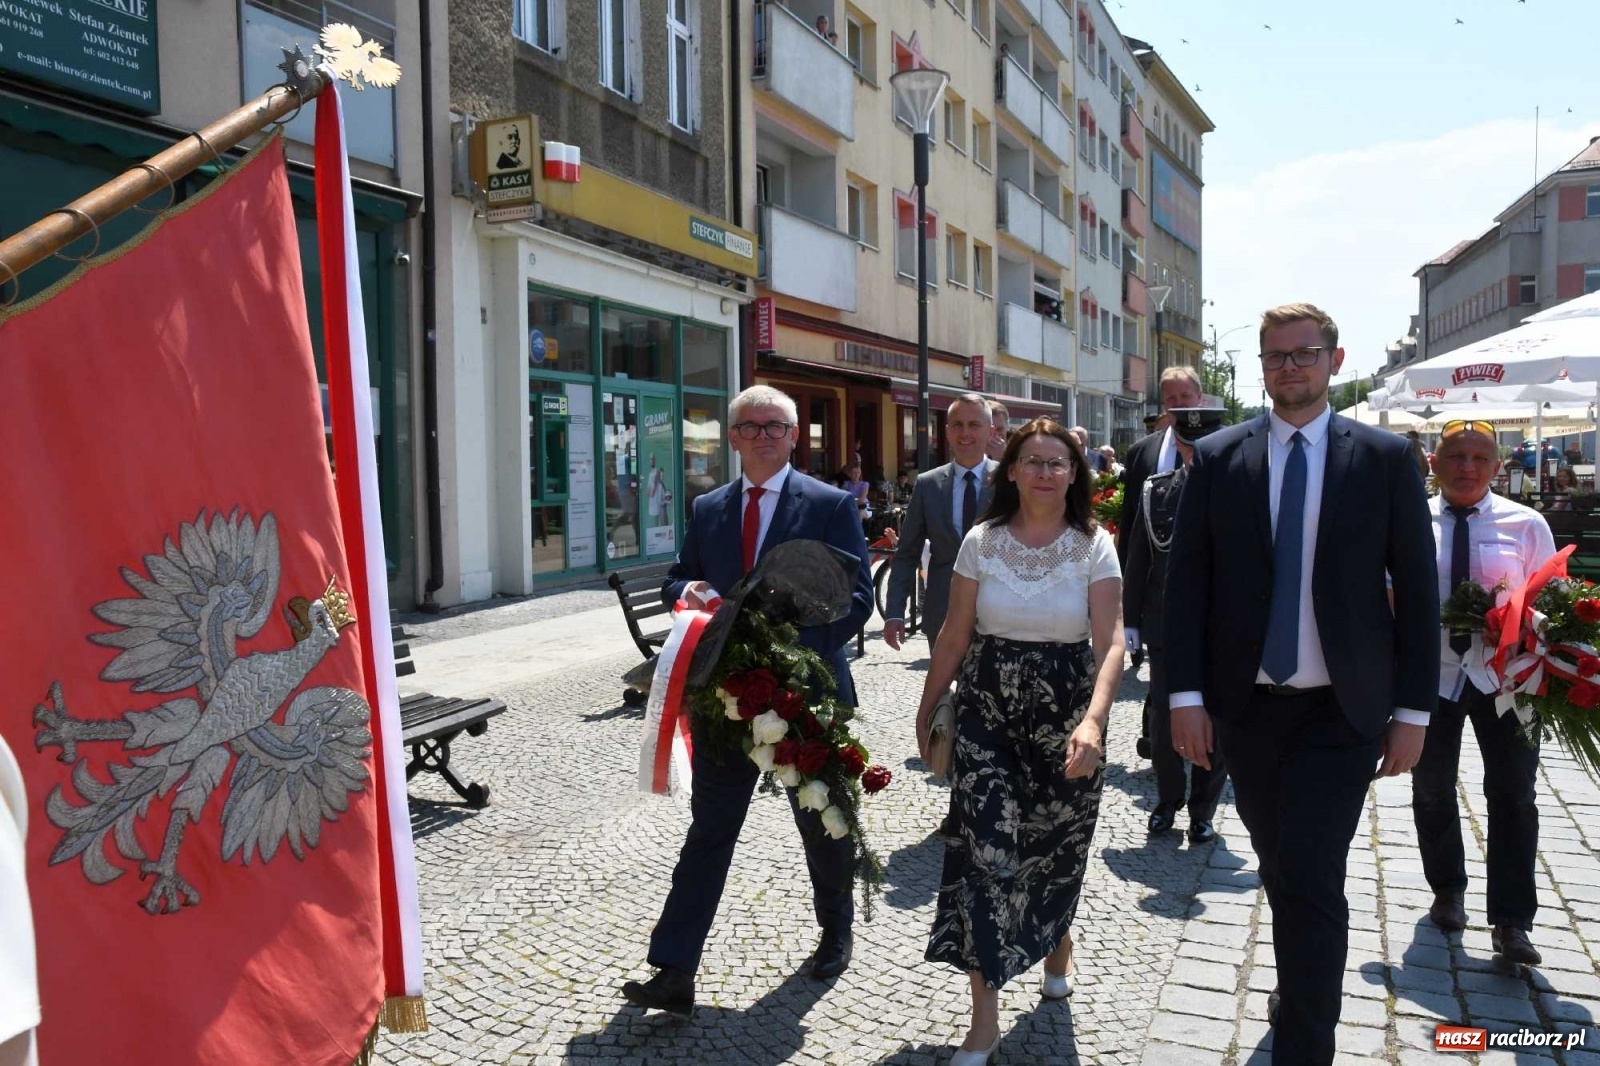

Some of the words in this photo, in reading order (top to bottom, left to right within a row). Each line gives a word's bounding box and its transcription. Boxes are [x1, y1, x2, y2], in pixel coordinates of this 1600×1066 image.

[69, 8, 105, 31] Stefan
[107, 22, 149, 46] Zientek
[81, 31, 140, 57] ADWOKAT
[97, 50, 110, 61] 602
[126, 60, 139, 70] 648
[17, 51, 52, 69] e-mail:
[54, 60, 152, 100] biuro@zientek.com.pl
[502, 173, 529, 187] KASY
[490, 187, 530, 201] STEFCZYKA
[692, 221, 724, 245] STEFCZYK
